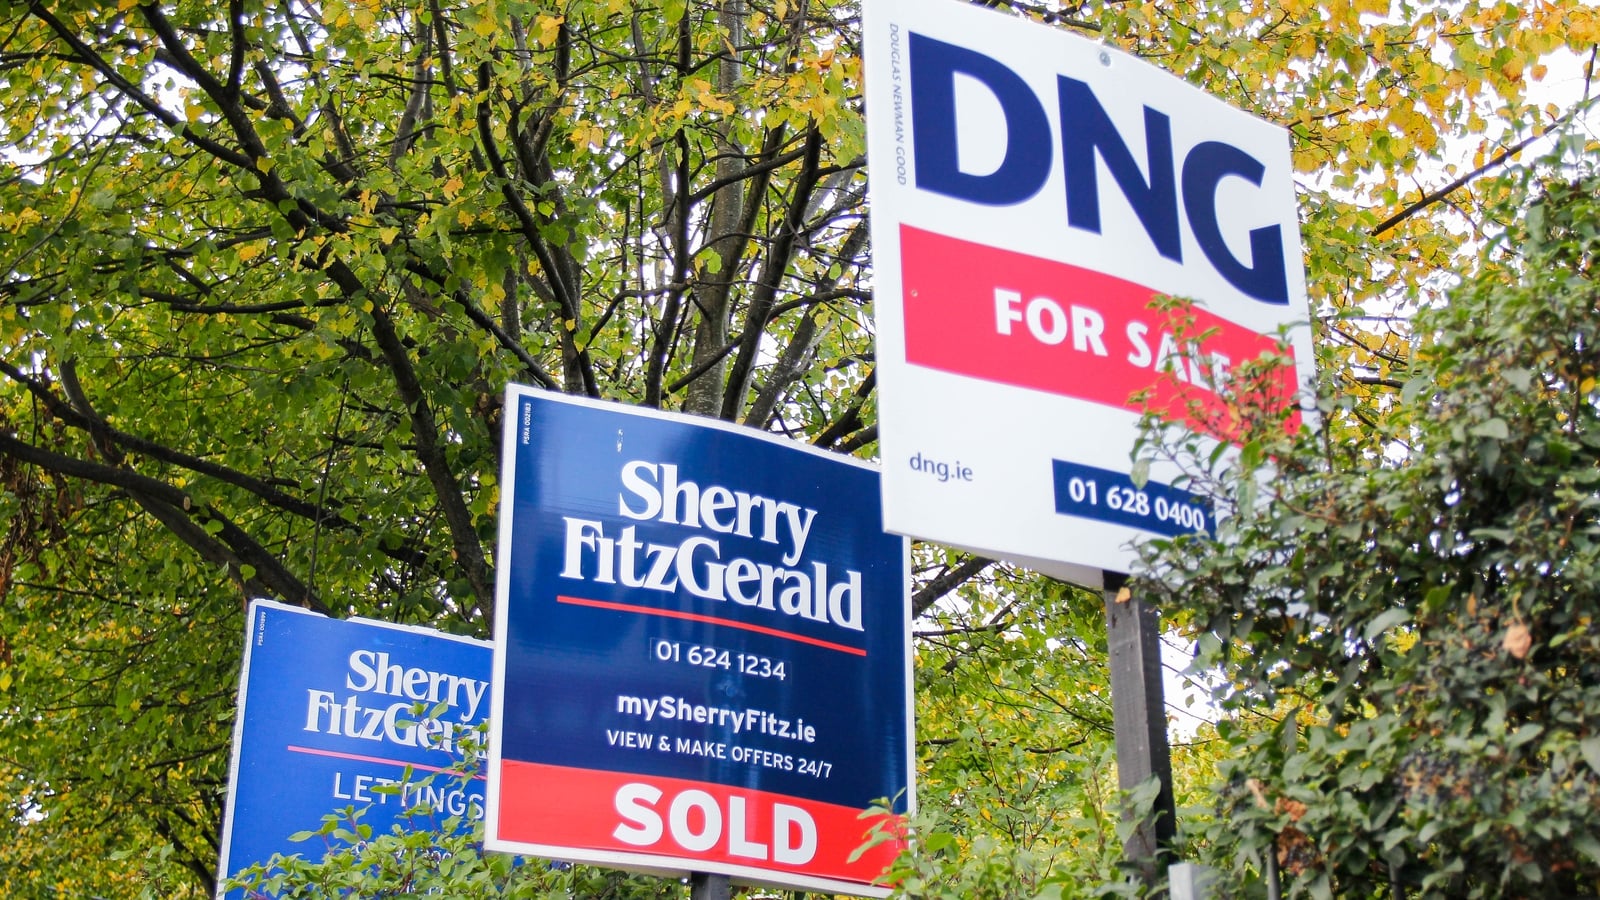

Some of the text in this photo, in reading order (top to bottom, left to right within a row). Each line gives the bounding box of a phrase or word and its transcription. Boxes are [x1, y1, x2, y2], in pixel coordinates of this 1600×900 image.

[889, 22, 907, 186] DOUGLAS NEWMAN GOOD
[908, 31, 1289, 305] DNG
[993, 287, 1232, 397] FOR SALE
[909, 452, 973, 482] dng.ie
[619, 460, 817, 566] Sherry
[1068, 477, 1205, 531] 01 628 0400
[560, 516, 865, 632] FitzGerald
[346, 649, 489, 722] Sherry
[656, 641, 786, 681] 01 624 1234
[607, 729, 833, 778] VIEW & MAKE OFFERS 24/7
[617, 695, 816, 743] mySherryFitz.ie
[333, 772, 484, 819] LETTINGS
[612, 782, 818, 865] SOLD
